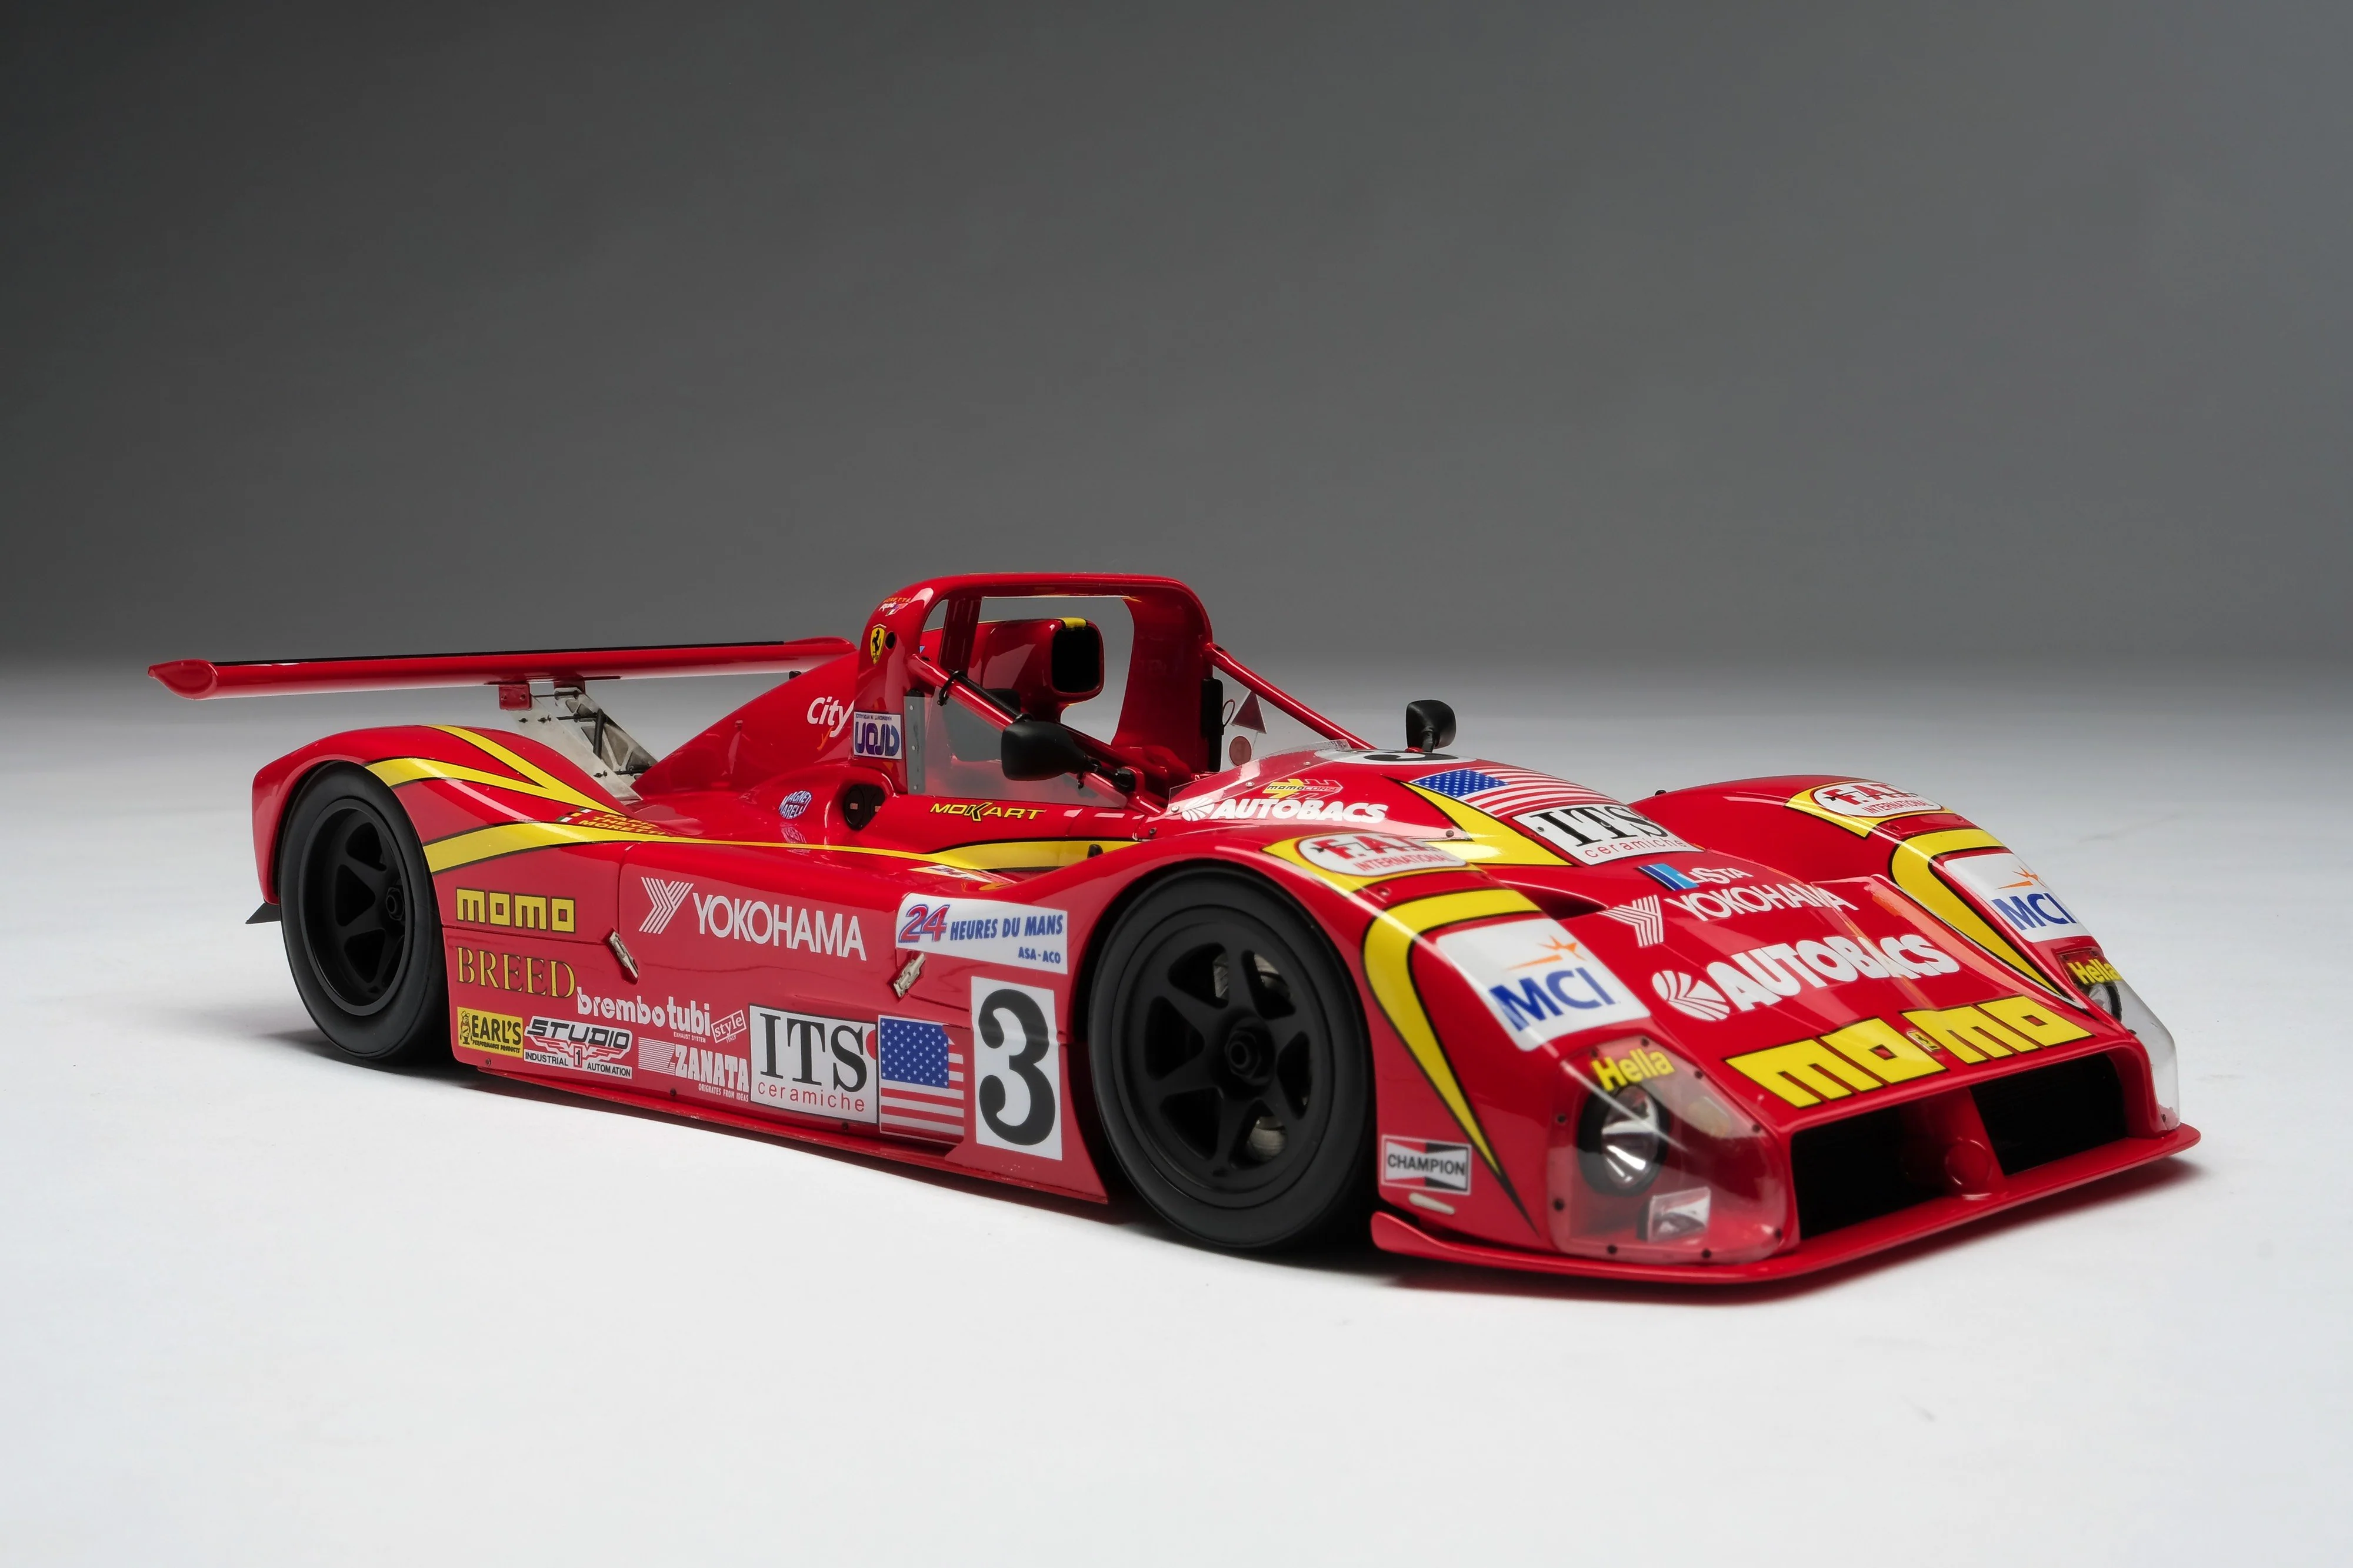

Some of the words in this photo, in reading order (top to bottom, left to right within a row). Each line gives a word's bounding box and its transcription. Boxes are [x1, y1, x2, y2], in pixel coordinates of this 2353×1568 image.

[806, 696, 855, 738] City
[594, 816, 654, 829] THEYS
[930, 802, 1047, 822] MOKART
[1209, 798, 1389, 823] AUTOBACS
[578, 819, 666, 835] MORETTI
[1529, 806, 1669, 848] ITS
[1353, 853, 1456, 872] INTERNATIONAL
[1584, 838, 1687, 858] ceramiche
[1665, 883, 1859, 922] YOKOHAMA
[1991, 892, 2077, 931] MCI
[692, 892, 866, 961] YOKOHAMA
[898, 903, 950, 943] 24
[950, 918, 998, 941] HEURES
[1002, 917, 1021, 938] DU
[1024, 915, 1063, 936] MANS
[456, 946, 576, 998] BREED
[1706, 933, 1960, 1012] AUTOBACS
[2067, 958, 2122, 985] Hella
[1488, 966, 1617, 1032] MCI
[472, 1015, 522, 1046] EARL'S
[527, 1019, 629, 1049] STUDIO
[673, 1031, 691, 1040] EXHAUST
[691, 1035, 706, 1043] SYSTEM
[714, 1016, 744, 1037] style
[525, 1052, 568, 1066] INDUSTRIAL
[760, 1013, 867, 1093] ITS
[978, 989, 1055, 1146] 3
[587, 1062, 631, 1077] AUTOMATION
[675, 1044, 749, 1093] ZANATA
[1592, 1048, 1675, 1092] Hella
[723, 1089, 735, 1099] FROM
[736, 1092, 749, 1103] IDEAS
[758, 1082, 865, 1112] ceramiche
[1387, 1152, 1467, 1176] CHAMPION
